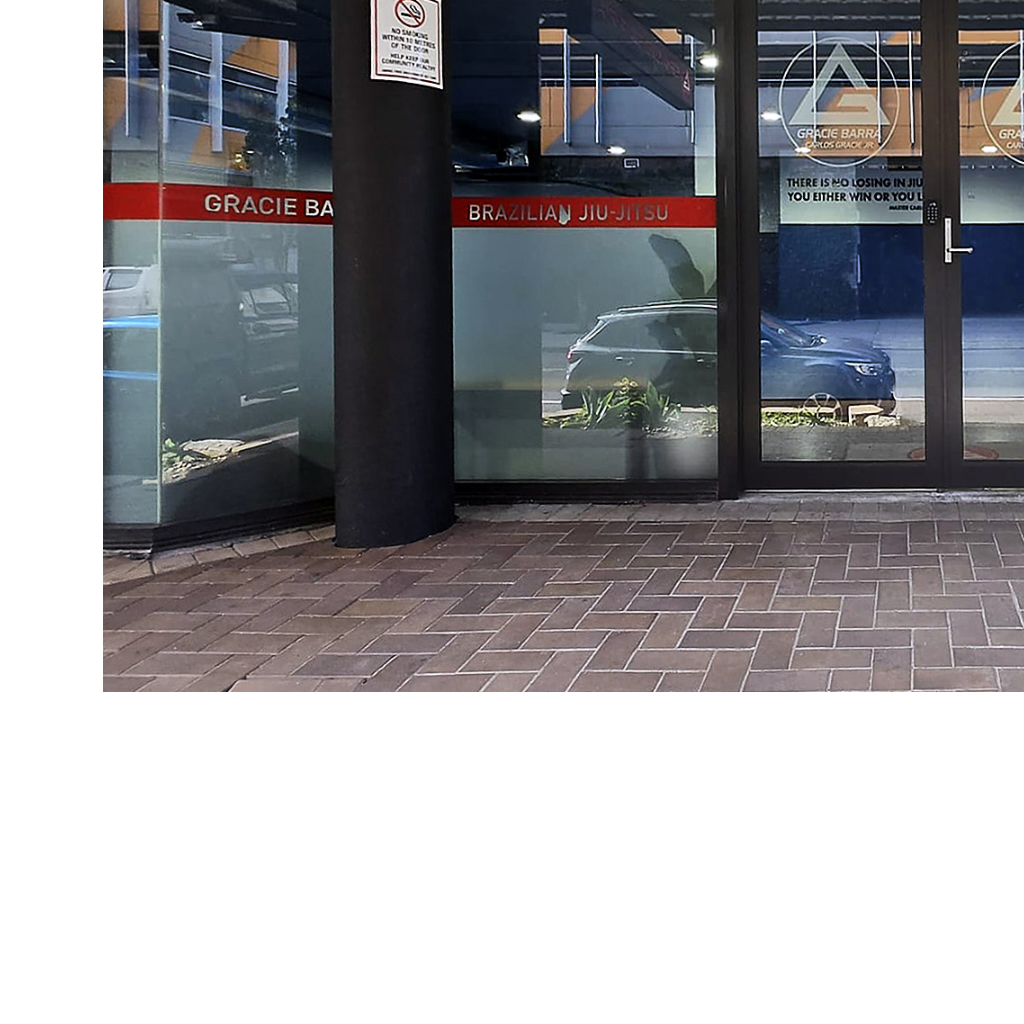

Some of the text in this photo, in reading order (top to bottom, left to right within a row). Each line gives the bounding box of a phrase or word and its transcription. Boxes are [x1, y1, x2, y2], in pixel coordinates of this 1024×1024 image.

[382, 34, 405, 43] WITHIN
[402, 29, 428, 40] SMOKING
[401, 43, 412, 51] THE
[797, 128, 880, 139] GRACIE BARRA
[787, 178, 923, 188] THERE IS NO LOSING IN JIU
[787, 192, 810, 202] YOU
[812, 192, 846, 202] EITHER
[849, 192, 872, 202] WIN
[873, 192, 890, 202] OR
[892, 192, 915, 202] YOU
[204, 193, 297, 216] GRACIE
[469, 204, 669, 223] BRAZILIAN JIU-JITSU
